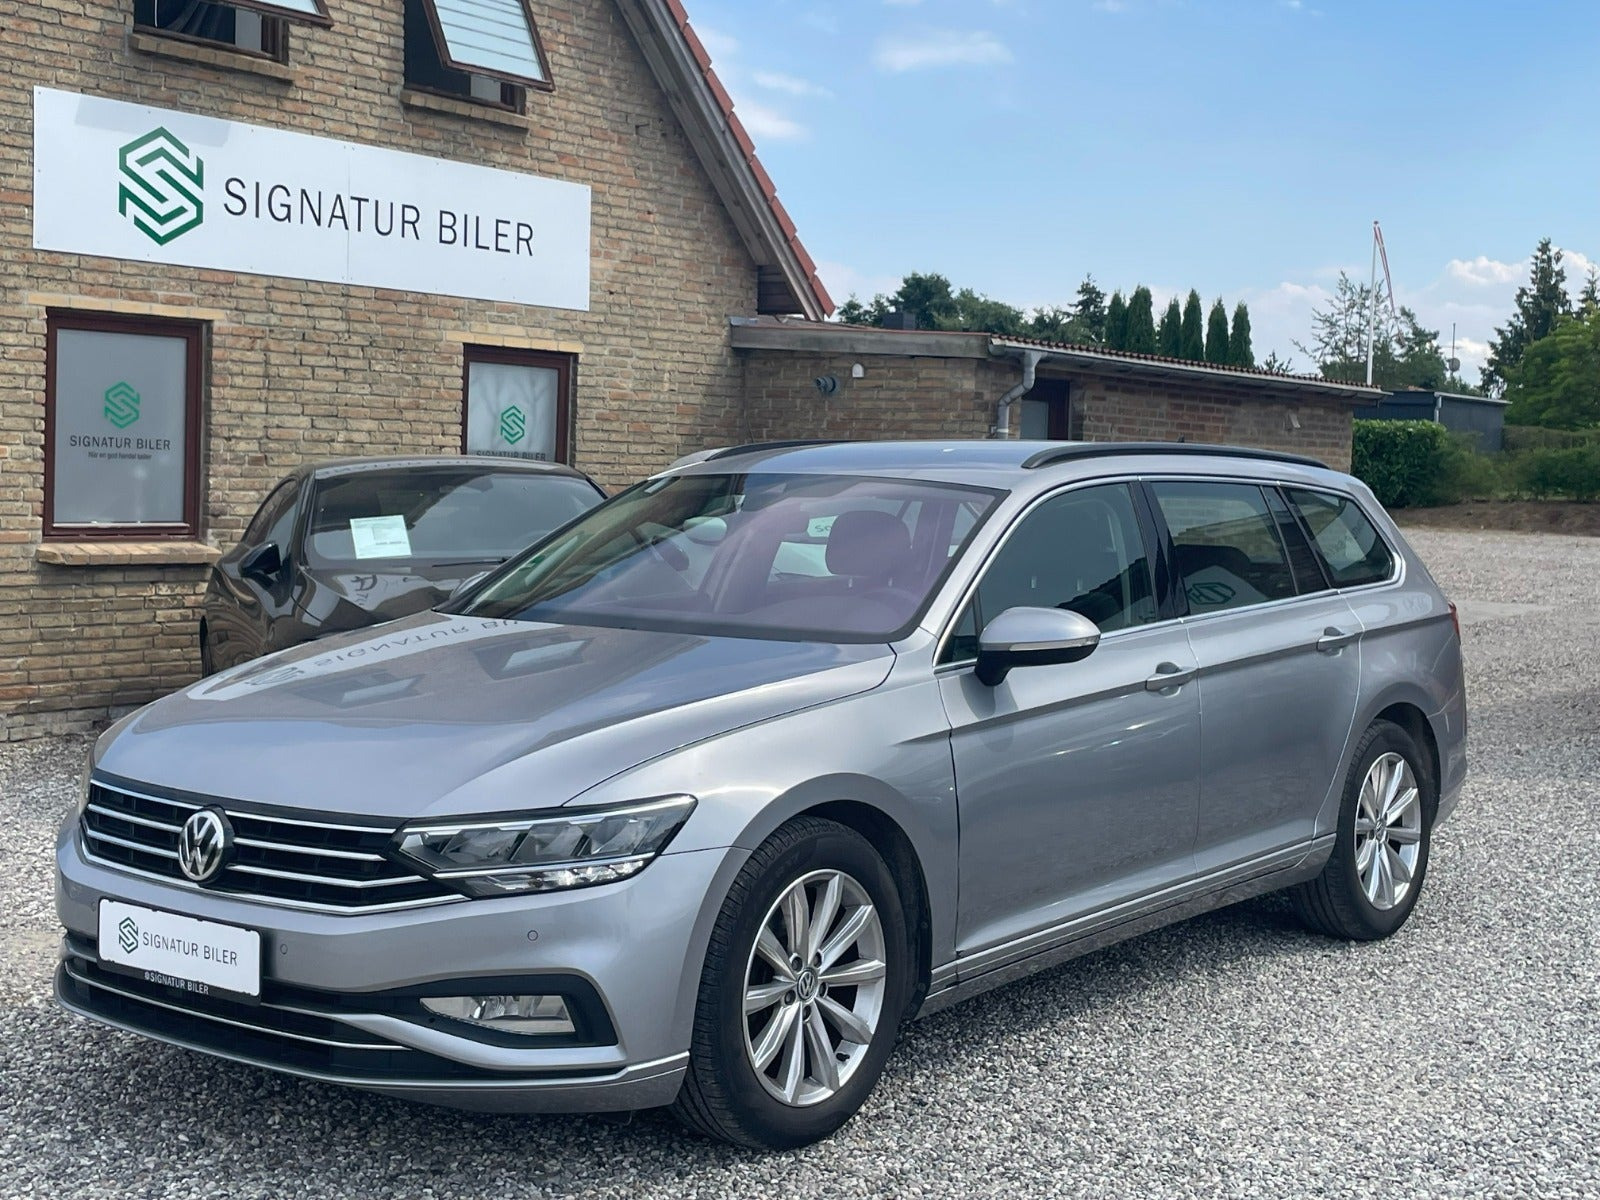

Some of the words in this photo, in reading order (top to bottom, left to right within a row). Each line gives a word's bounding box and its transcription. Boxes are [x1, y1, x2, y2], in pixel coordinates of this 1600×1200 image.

[223, 177, 420, 241] SIGNATUR
[438, 209, 534, 257] BILER
[69, 434, 132, 449] SIGNATUR
[136, 438, 171, 451] BILER
[142, 931, 198, 957] SIGNATUR
[203, 945, 238, 966] BILER
[187, 981, 209, 995] BILER
